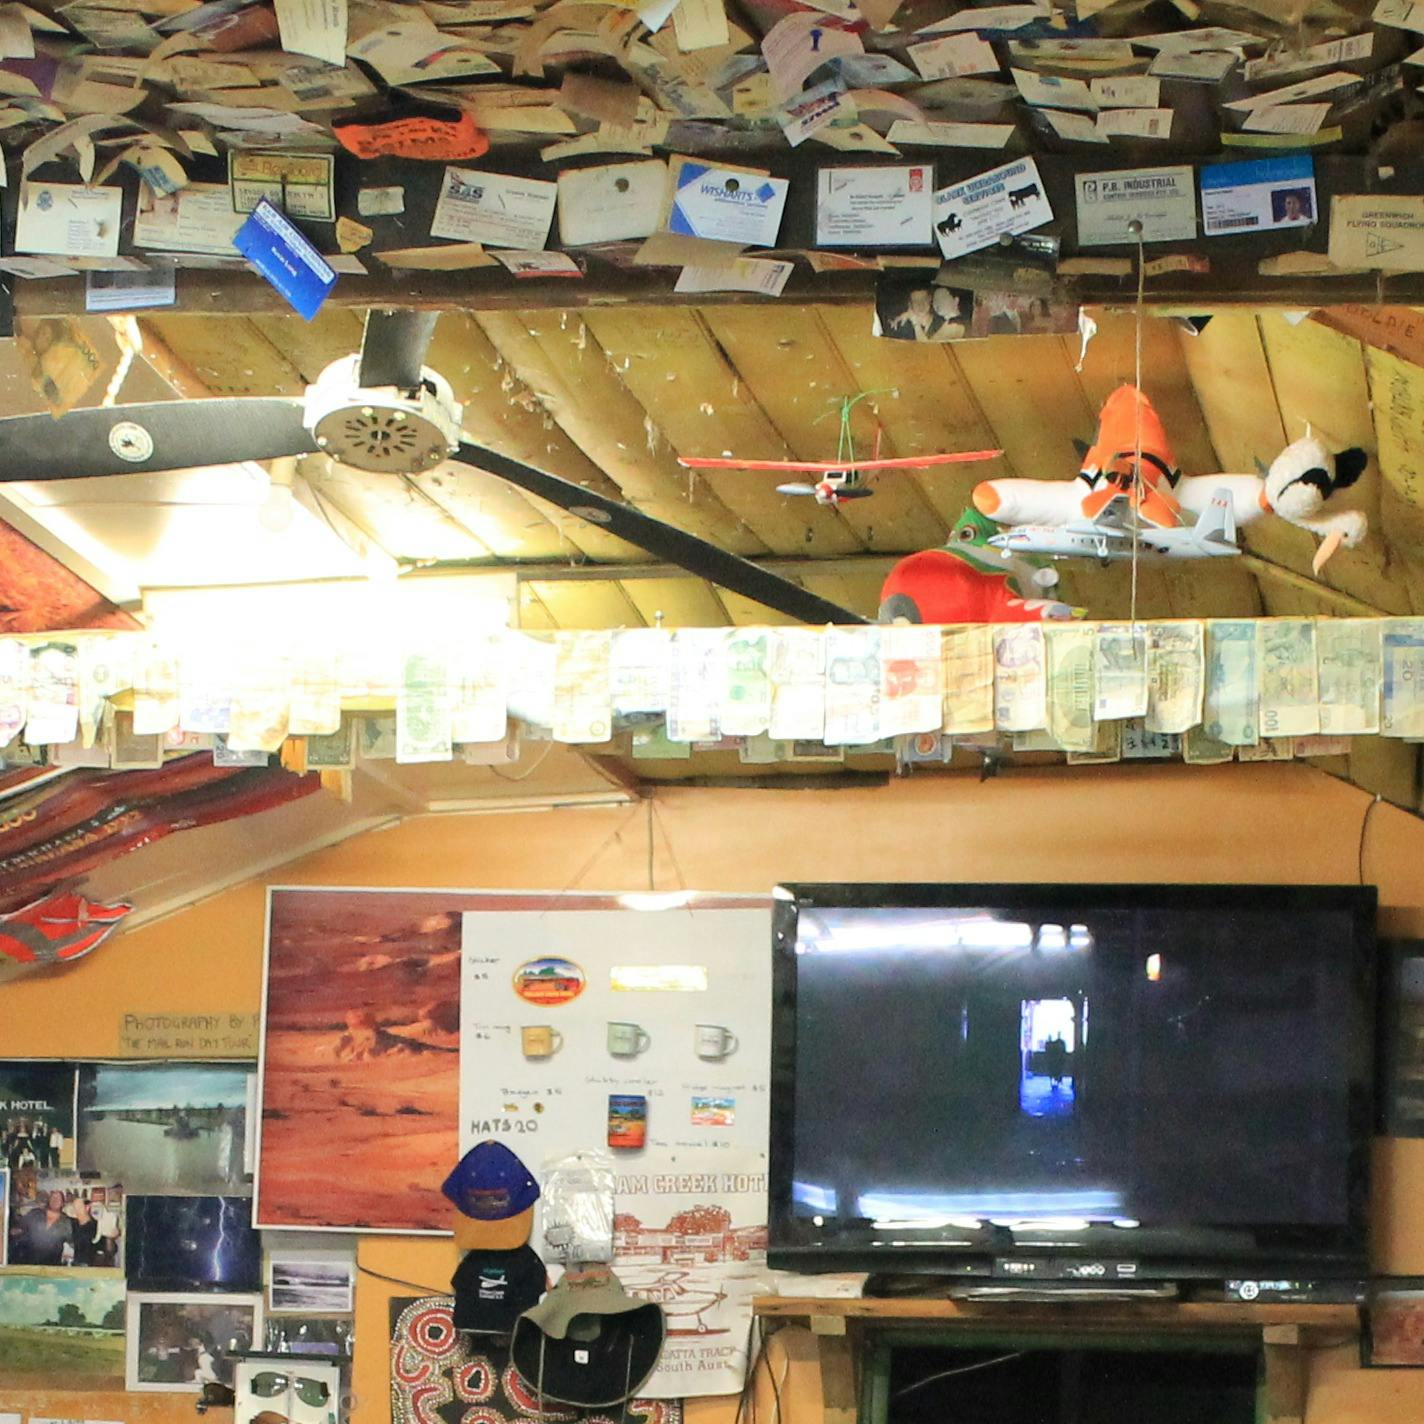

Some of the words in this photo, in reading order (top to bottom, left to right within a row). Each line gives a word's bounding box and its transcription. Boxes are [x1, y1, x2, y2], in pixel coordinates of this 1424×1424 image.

[1123, 176, 1177, 191] INDUSTRIAL
[1362, 210, 1414, 221] GREENWICH
[125, 1014, 221, 1032] PHOTOGRAPHY
[229, 1016, 247, 1030] BY
[654, 1175, 718, 1194] CREEK
